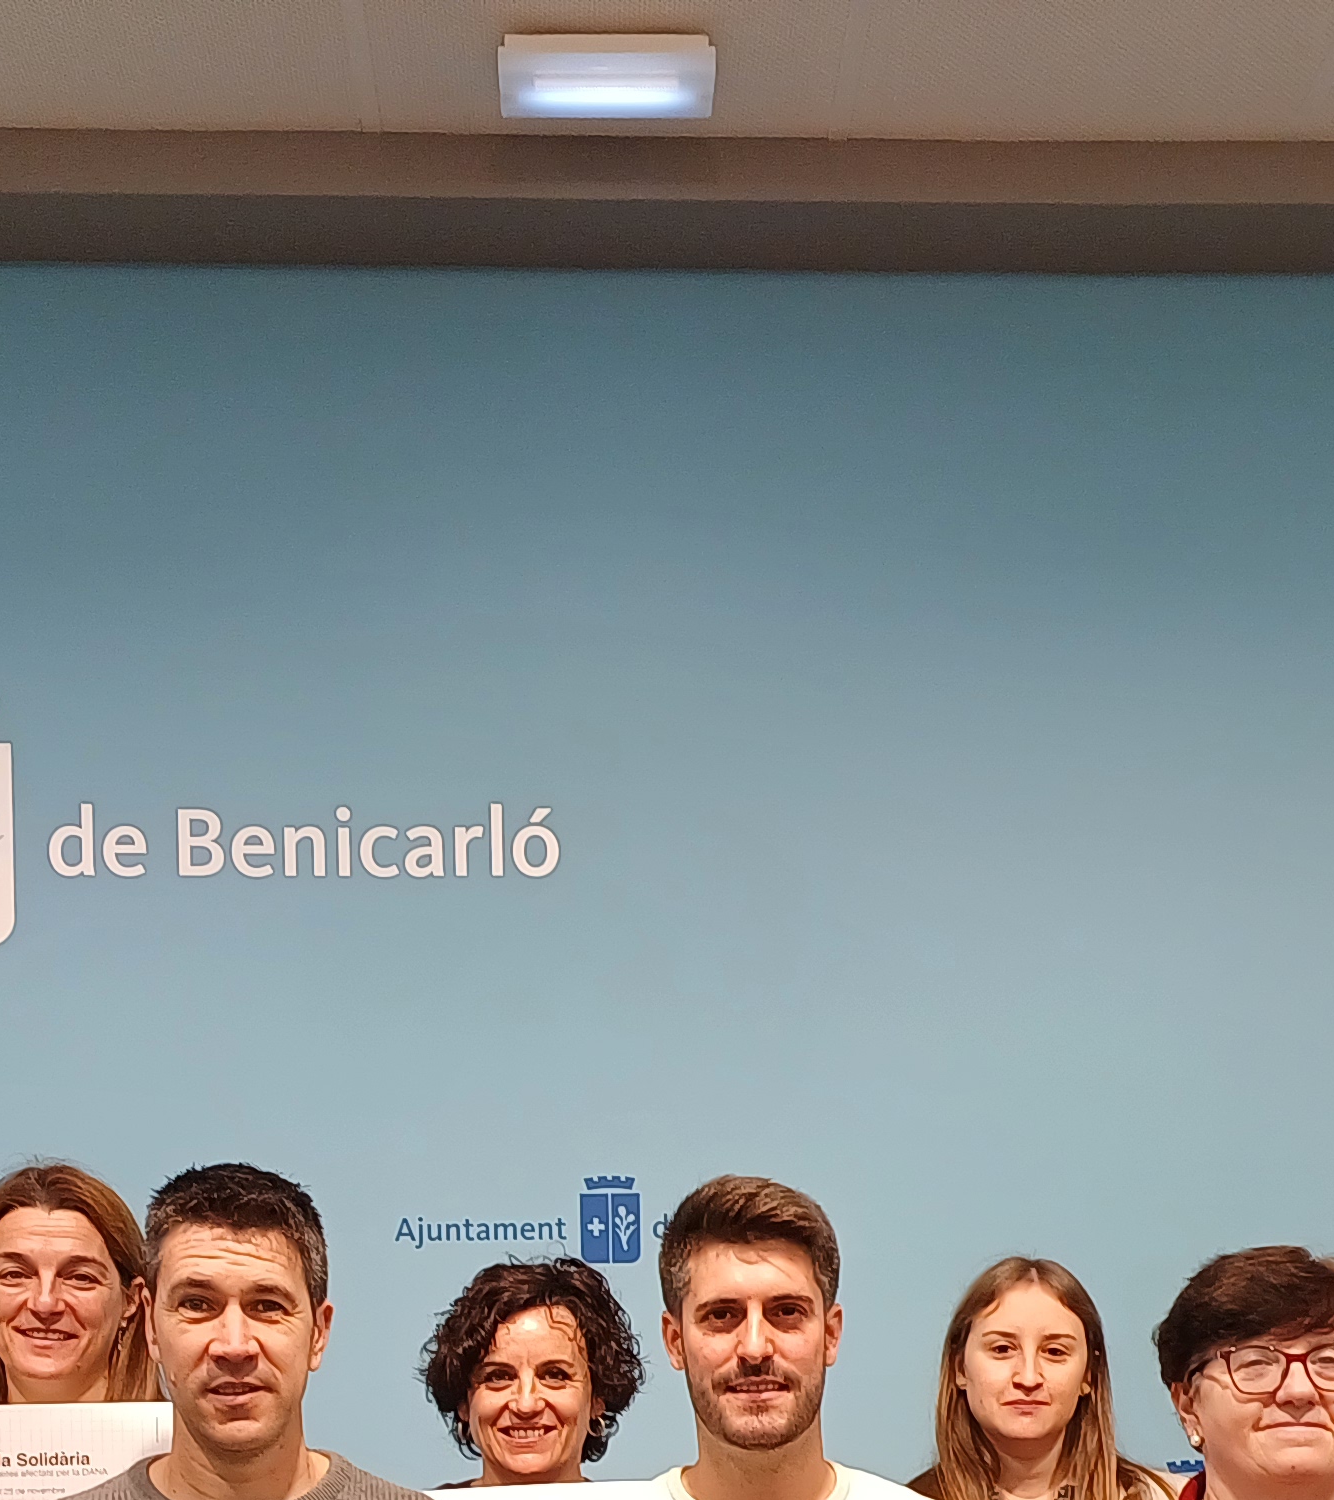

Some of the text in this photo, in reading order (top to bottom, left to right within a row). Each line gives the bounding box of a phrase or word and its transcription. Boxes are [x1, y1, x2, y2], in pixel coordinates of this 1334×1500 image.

[47, 804, 148, 878] de
[176, 802, 561, 878] Benicarló
[395, 1213, 669, 1249] Ajuntament d
[17, 1452, 90, 1466] Solidària
